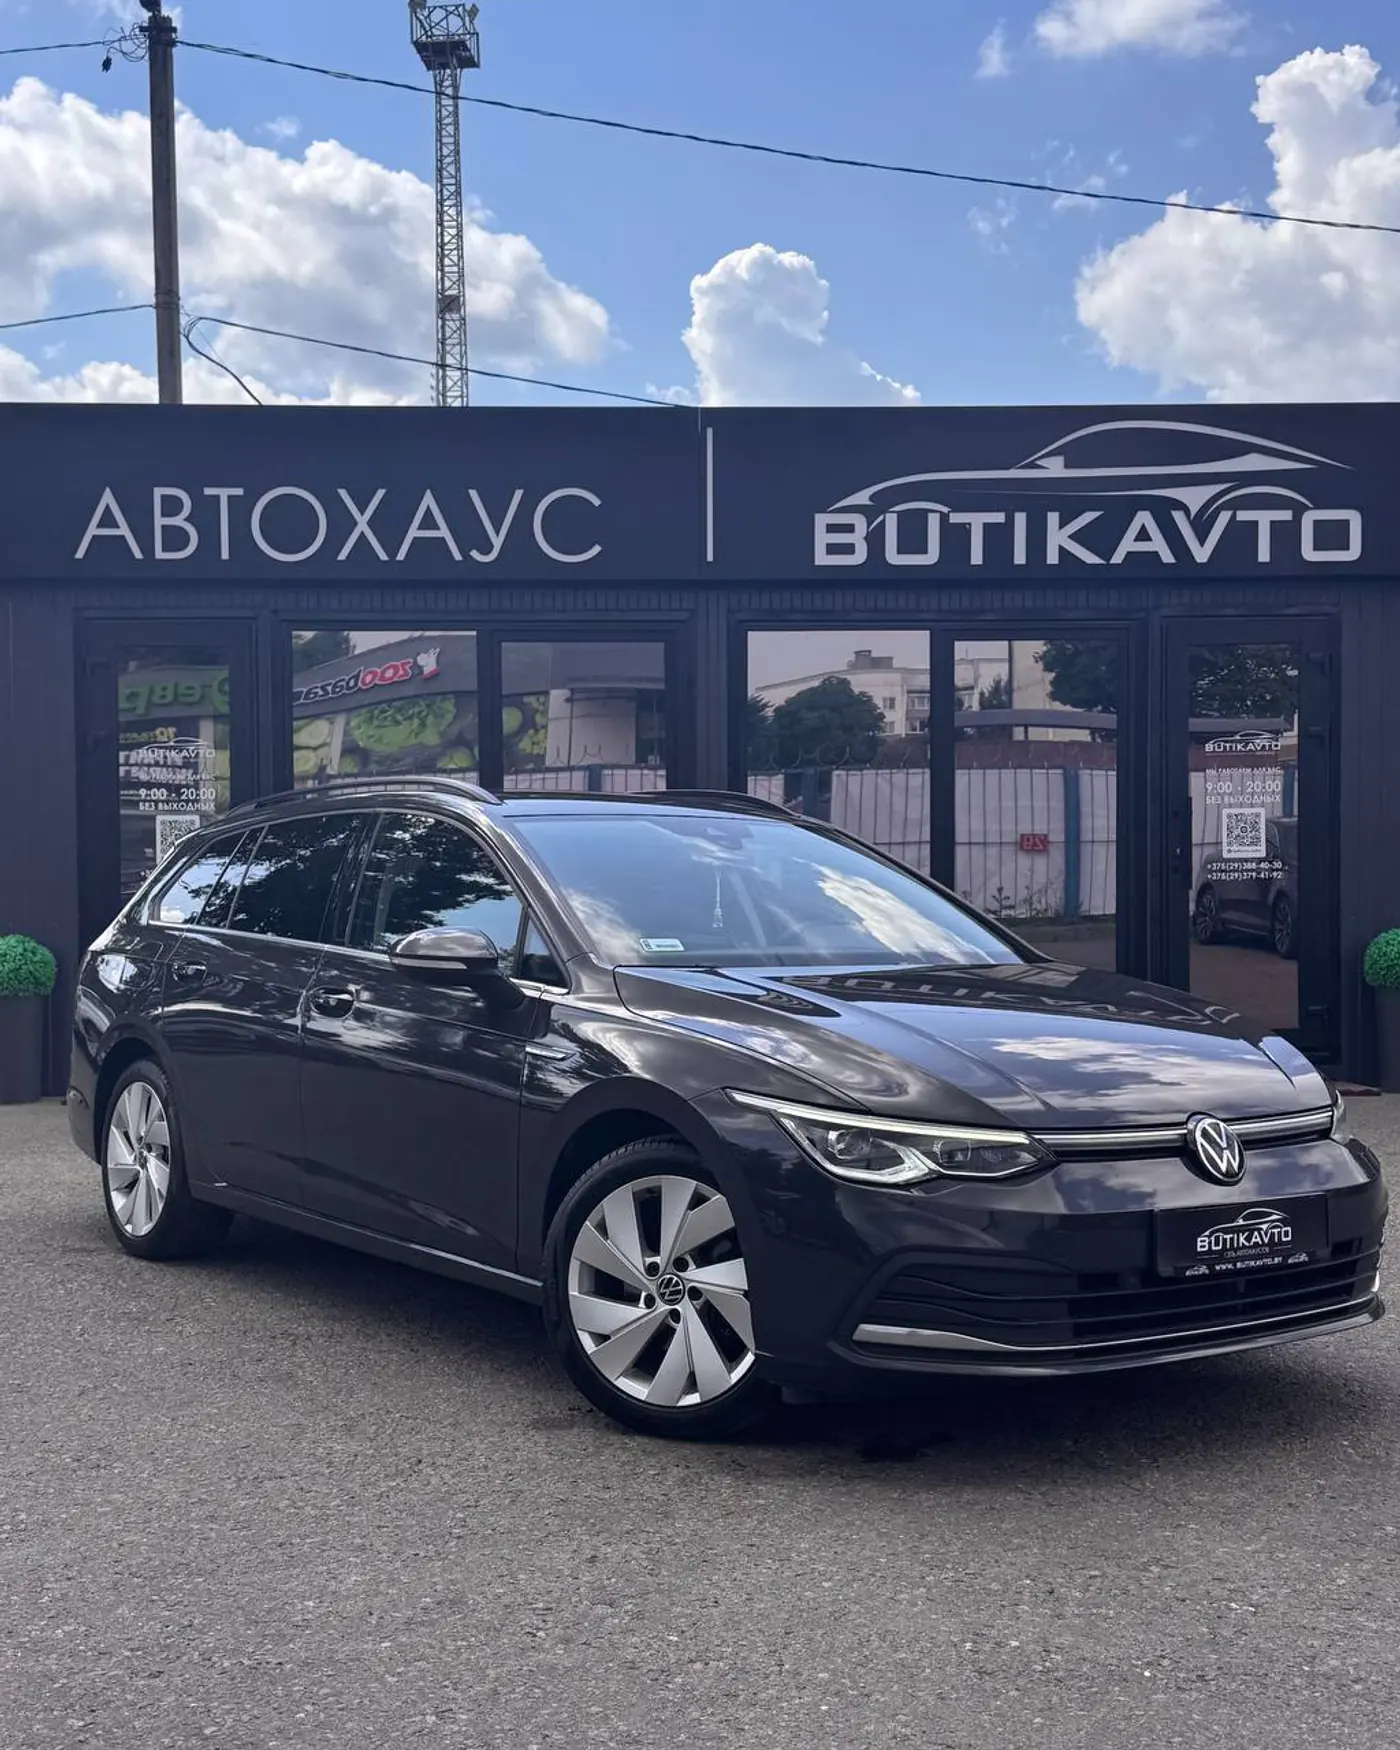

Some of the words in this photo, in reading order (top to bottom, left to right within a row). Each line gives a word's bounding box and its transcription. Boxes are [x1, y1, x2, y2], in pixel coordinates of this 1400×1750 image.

[74, 486, 603, 564] АВТОХАУС
[813, 508, 1362, 566] BUTIKAVTO
[1204, 742, 1281, 752] BUTIKAVTO
[1206, 781, 1233, 793] 9:00
[1246, 780, 1281, 792] 20:00
[139, 788, 167, 800] 9:00
[180, 788, 216, 800] 20:00
[1206, 795, 1221, 804] БЕЗ
[1223, 794, 1281, 804] ВЫХОДНЫХ
[139, 801, 156, 811] БЕЗ
[157, 801, 216, 811] ВЫХОДНЫХ
[1196, 1226, 1292, 1252] BUTIKAVTO
